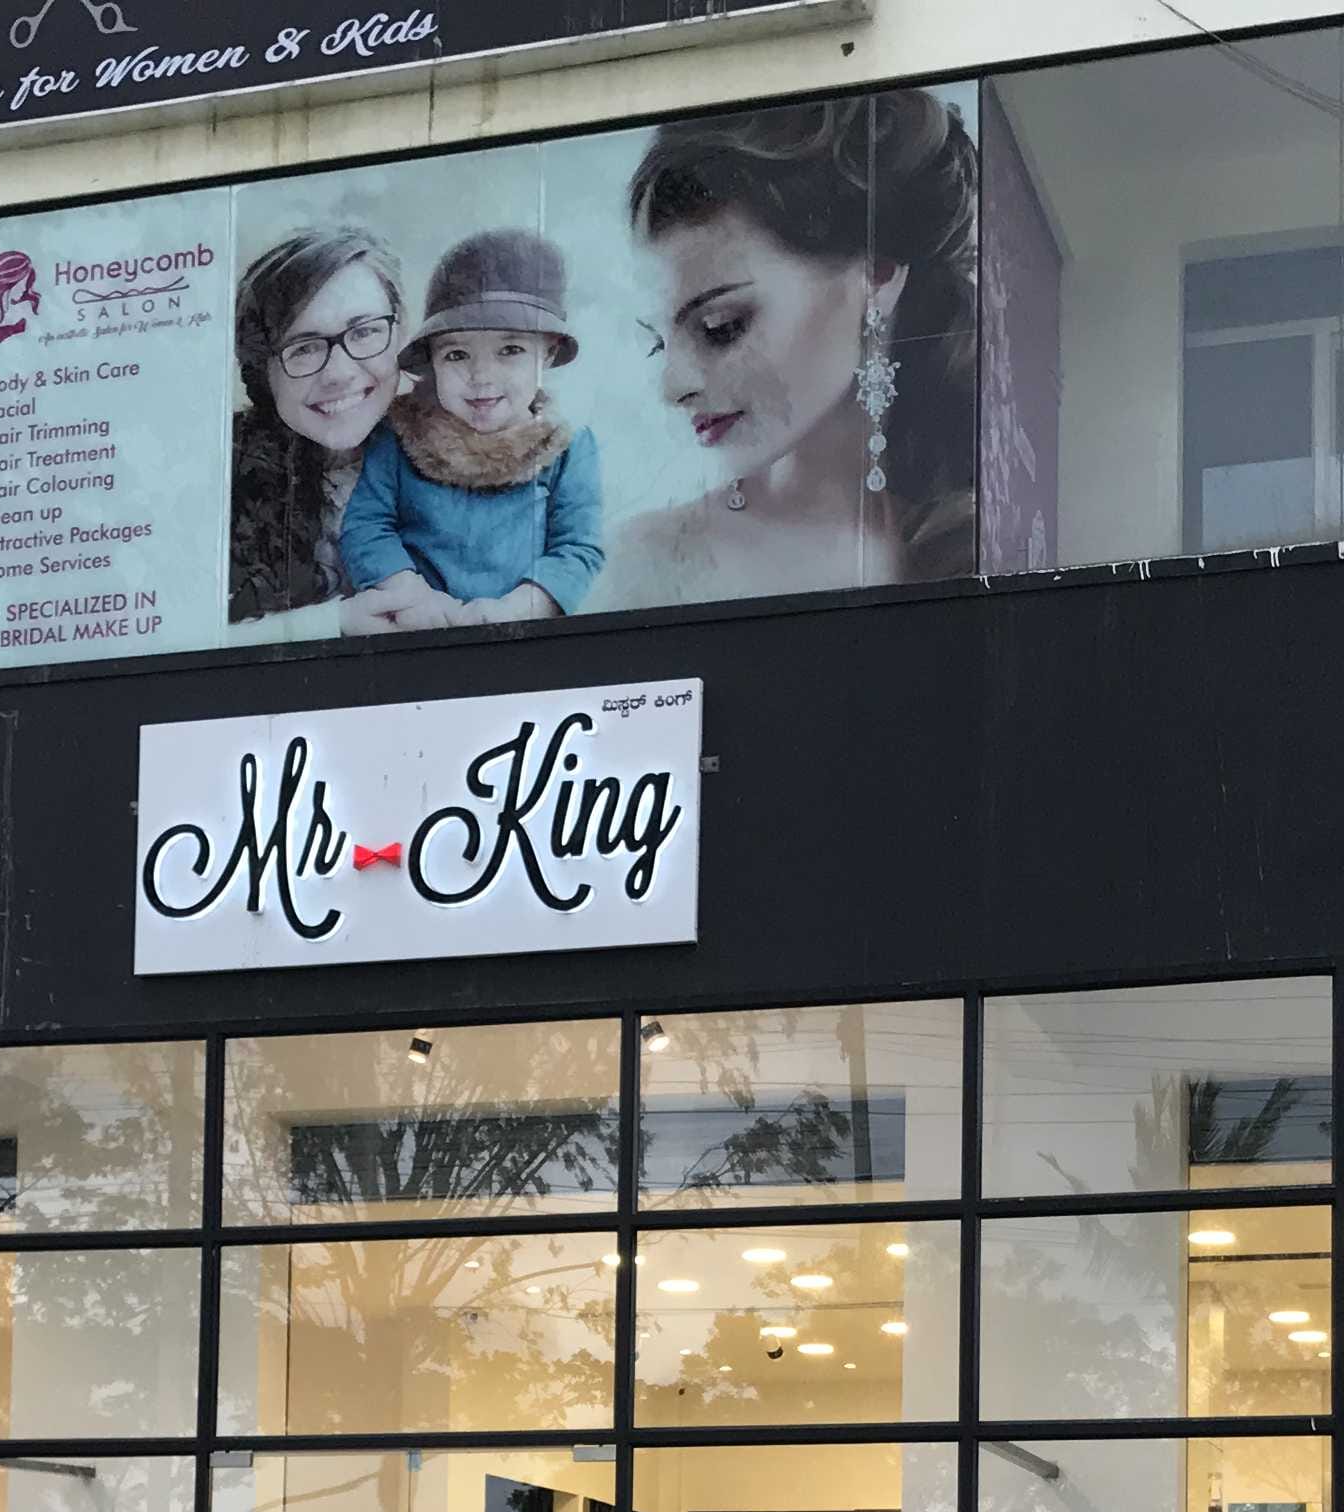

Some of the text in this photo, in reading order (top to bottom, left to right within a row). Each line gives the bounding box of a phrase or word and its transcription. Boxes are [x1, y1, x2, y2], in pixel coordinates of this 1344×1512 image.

[9, 66, 79, 110] for
[95, 42, 250, 87] Women
[264, 28, 311, 63] &
[321, 9, 440, 57] Kids
[55, 243, 214, 286] Honeycomb
[76, 296, 181, 321] SALON
[34, 371, 47, 388] &
[53, 366, 90, 386] Skin
[96, 362, 140, 380] Care
[28, 419, 110, 442] Trimming
[28, 444, 116, 468] Treatment
[26, 472, 114, 496] Colouring
[40, 507, 63, 523] up
[70, 522, 152, 544] Packages
[40, 554, 111, 574] Services
[6, 590, 156, 622] SPECIALIZED IN
[0, 615, 162, 648] BRIDAL MAKE UP
[142, 712, 683, 941] Mr King
